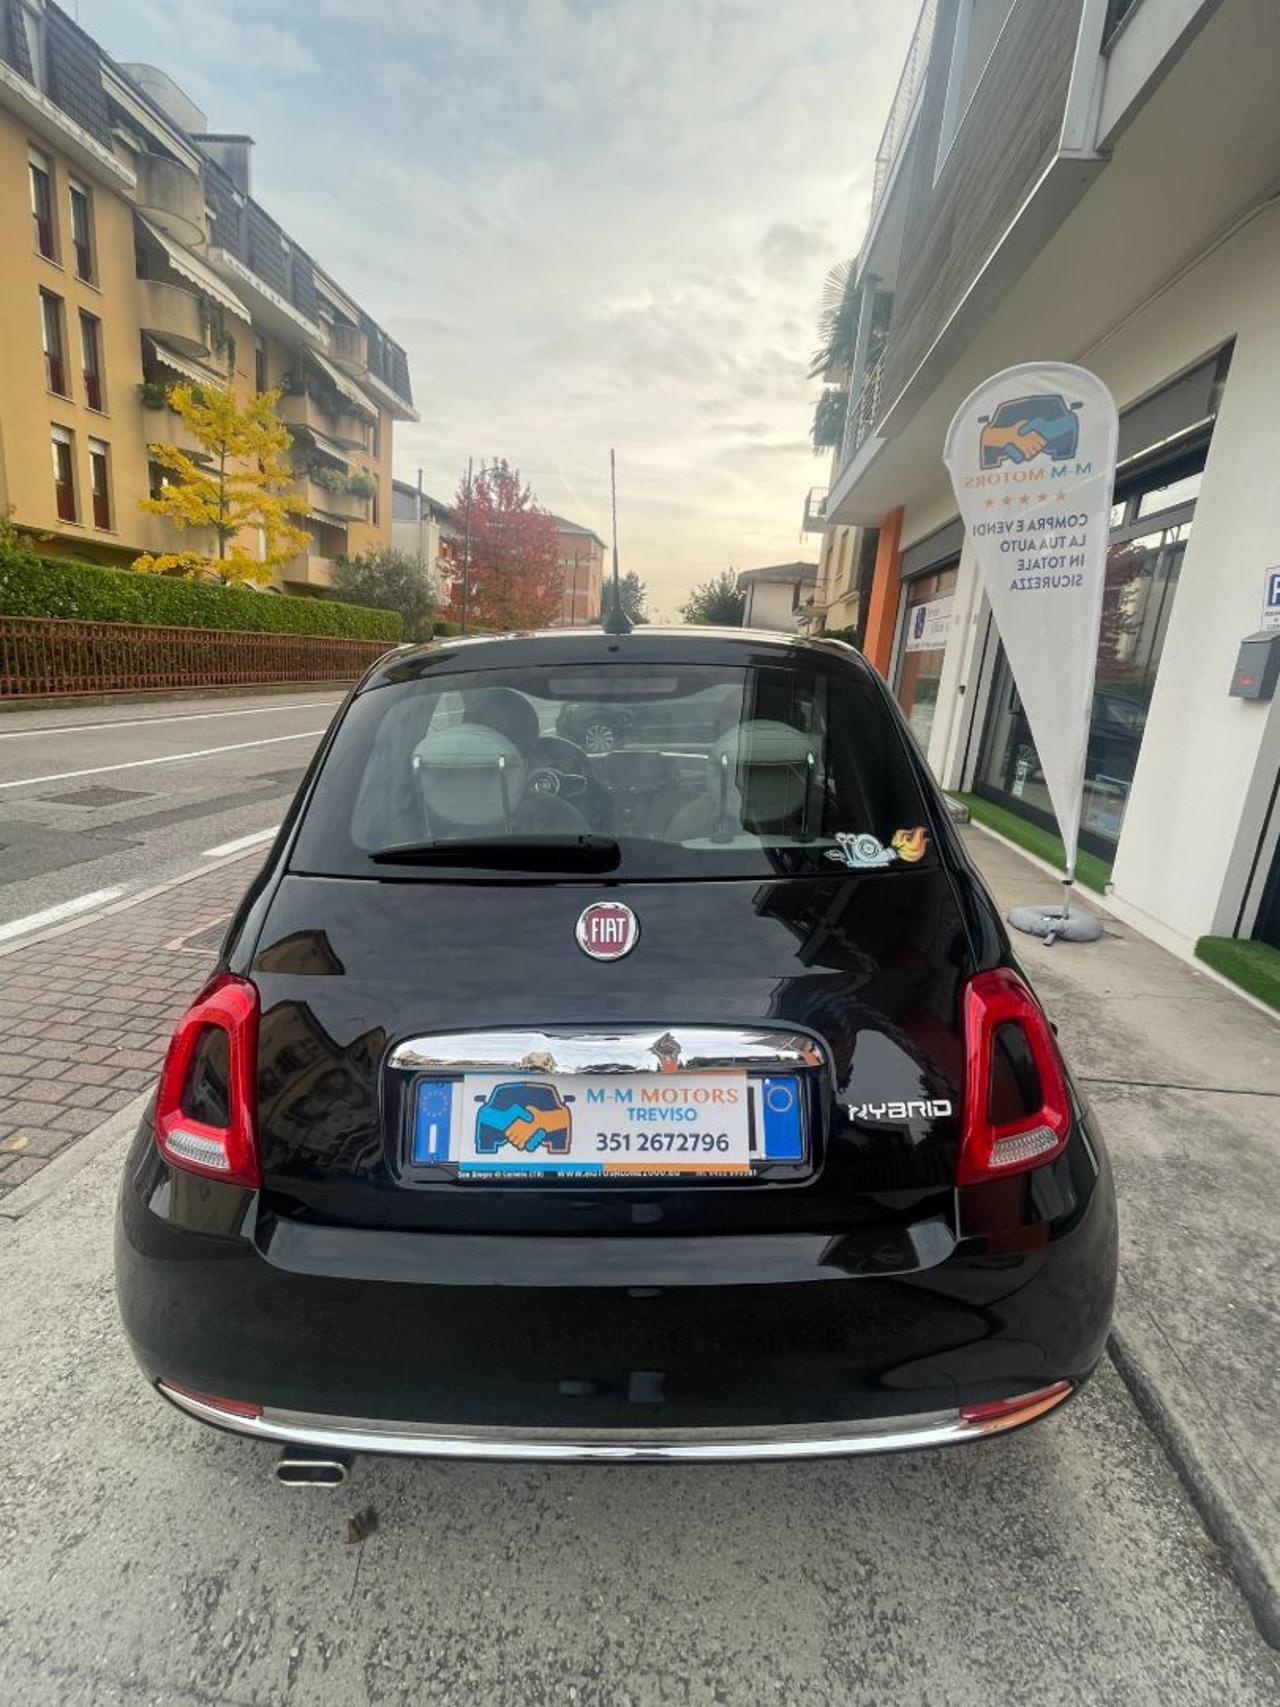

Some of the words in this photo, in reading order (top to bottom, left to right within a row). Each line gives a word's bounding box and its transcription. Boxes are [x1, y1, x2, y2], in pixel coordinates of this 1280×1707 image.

[591, 917, 627, 943] FIAT
[587, 1088, 633, 1103] M-M
[640, 1088, 739, 1104] MOTORS
[628, 1107, 697, 1122] TREVISO
[848, 1100, 952, 1121] HYBRID
[596, 1133, 631, 1152] 351
[636, 1133, 730, 1152] 2672796
